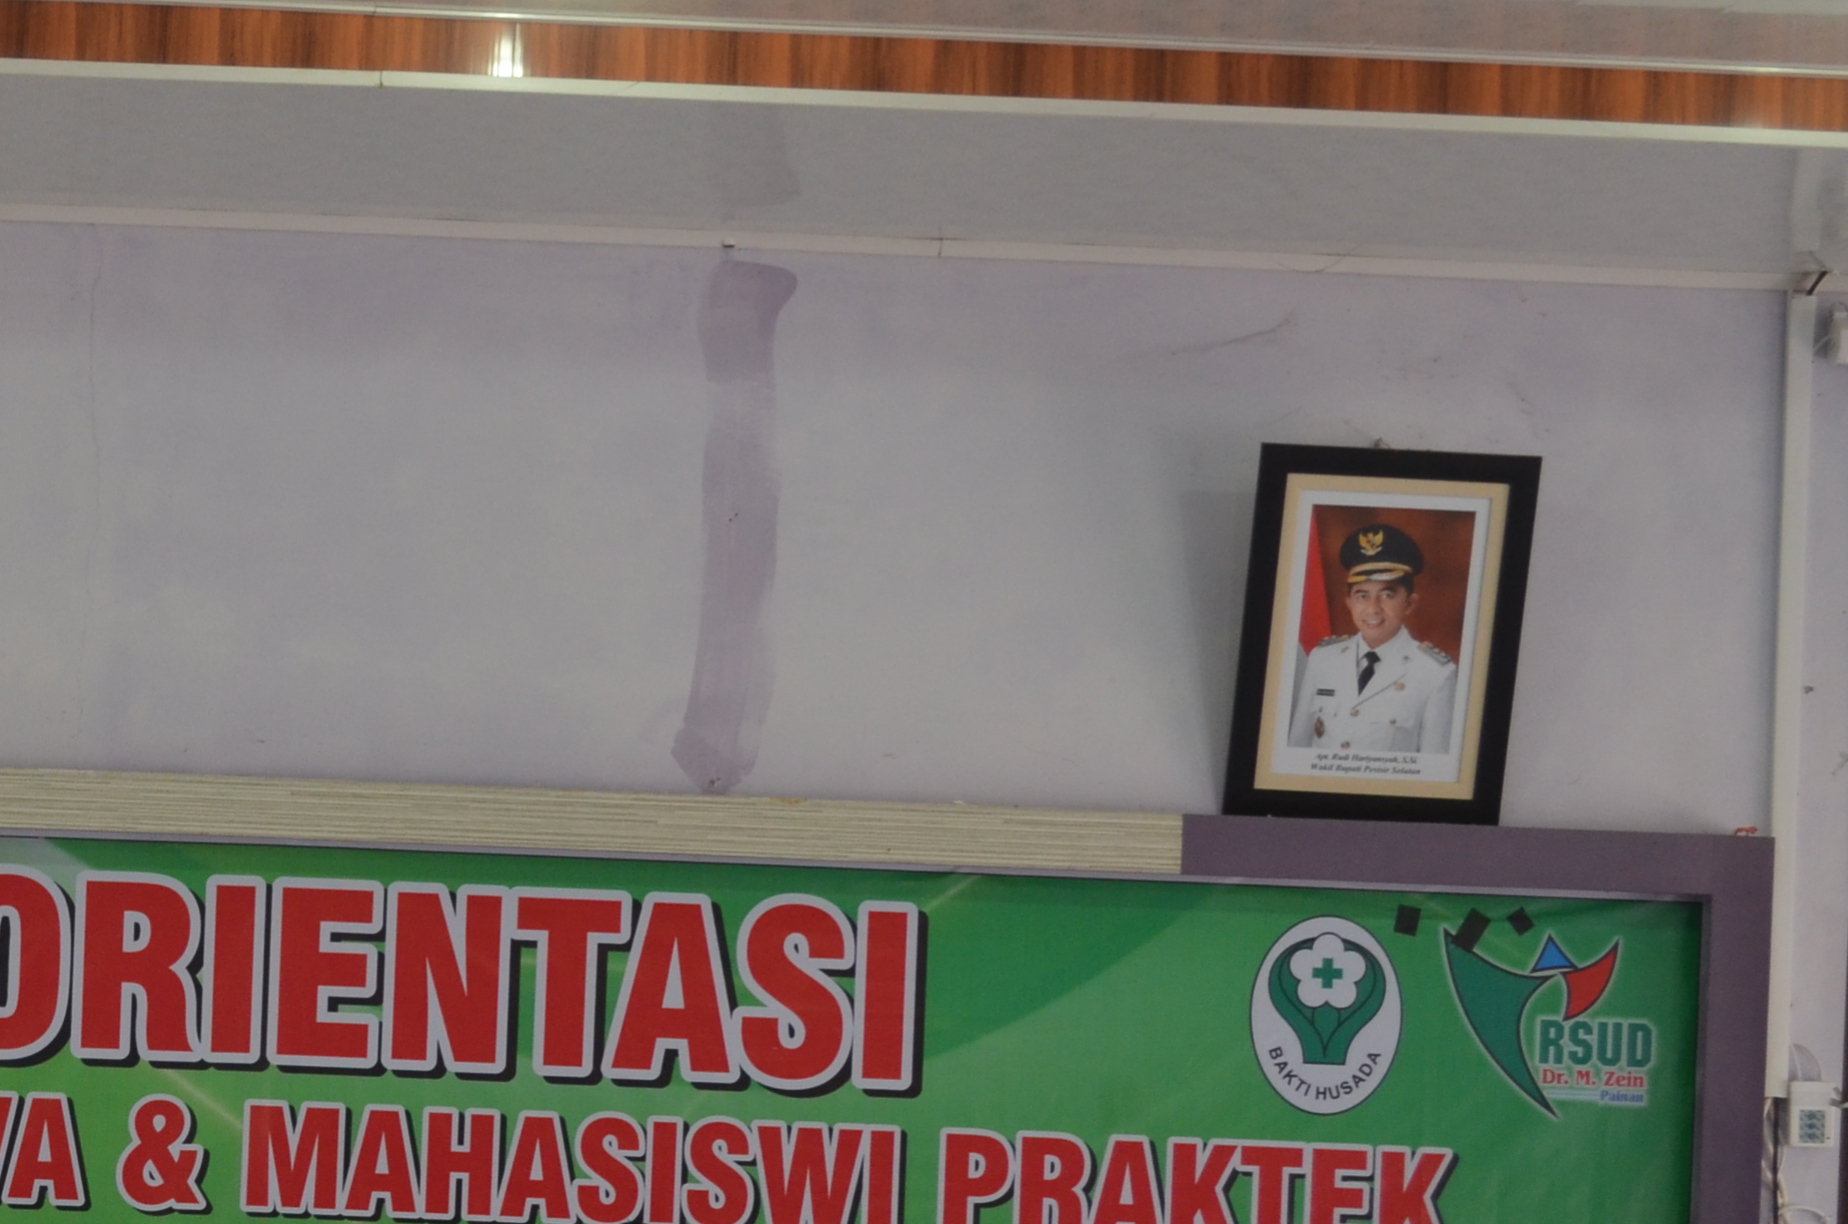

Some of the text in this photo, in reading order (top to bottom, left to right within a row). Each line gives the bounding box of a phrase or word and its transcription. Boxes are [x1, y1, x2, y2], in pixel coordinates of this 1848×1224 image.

[1538, 1019, 1652, 1068] RSUD
[1268, 1046, 1382, 1101] BAKTI HUSADA
[1542, 1068, 1645, 1088] Dr. M. Zein
[1600, 1090, 1644, 1103] Painan
[120, 1098, 205, 1209] &
